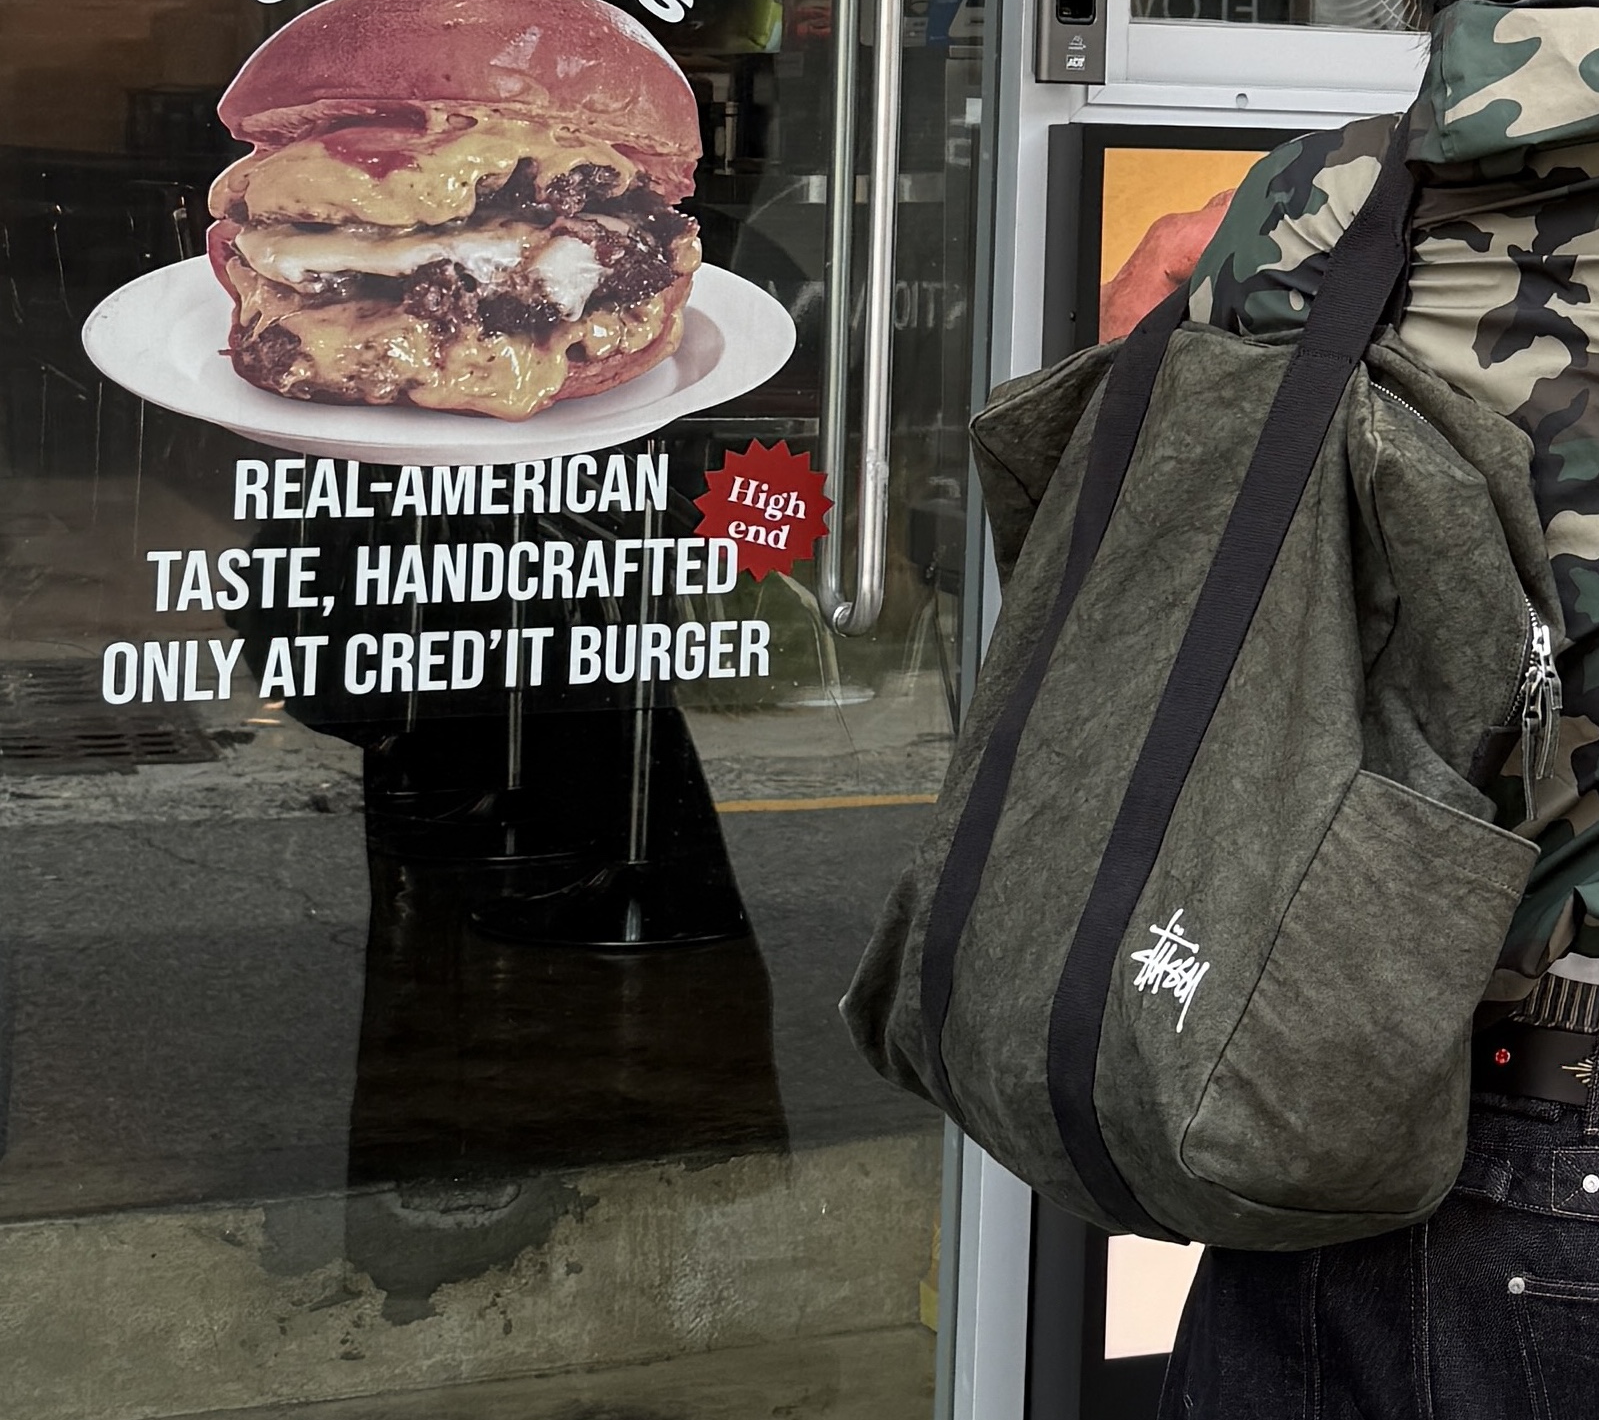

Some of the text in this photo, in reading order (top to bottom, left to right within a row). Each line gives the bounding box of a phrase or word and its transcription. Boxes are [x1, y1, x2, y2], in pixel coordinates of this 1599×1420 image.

[233, 452, 669, 521] REAL-AMERICAN
[727, 475, 807, 523] High
[727, 517, 789, 552] end
[147, 537, 739, 617] TASTE, HANDCRAFTED
[102, 619, 771, 705] ONLY AT CRED'IT BURGER
